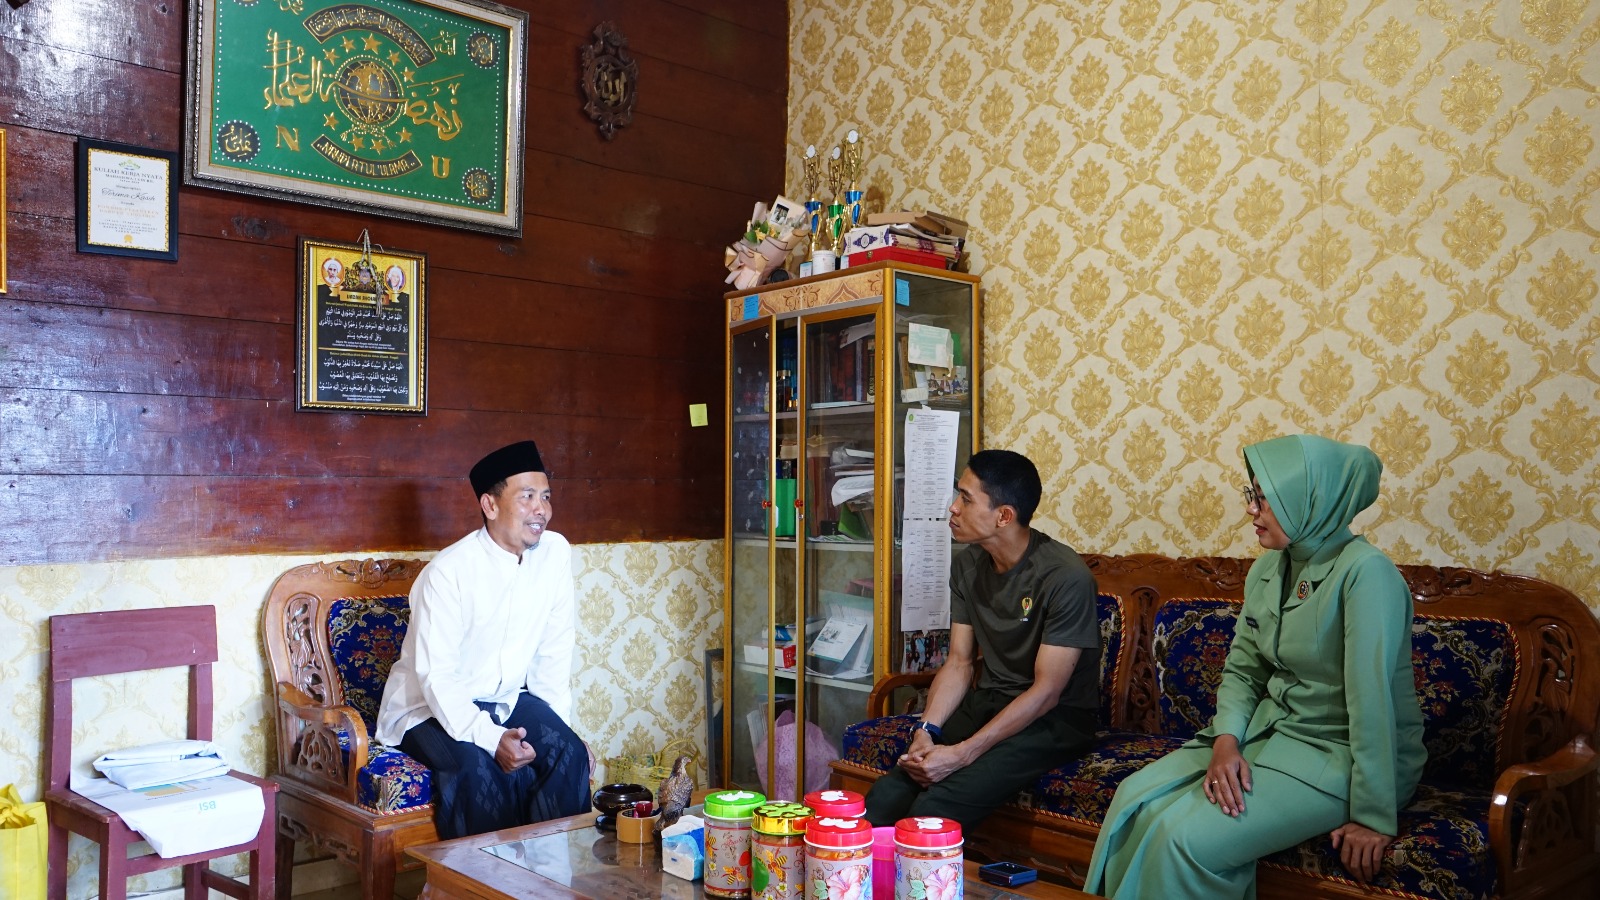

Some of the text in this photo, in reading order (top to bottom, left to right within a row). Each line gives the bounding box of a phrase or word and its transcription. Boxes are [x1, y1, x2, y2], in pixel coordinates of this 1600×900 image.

[276, 125, 451, 180] N U
[198, 800, 217, 811] BSI
